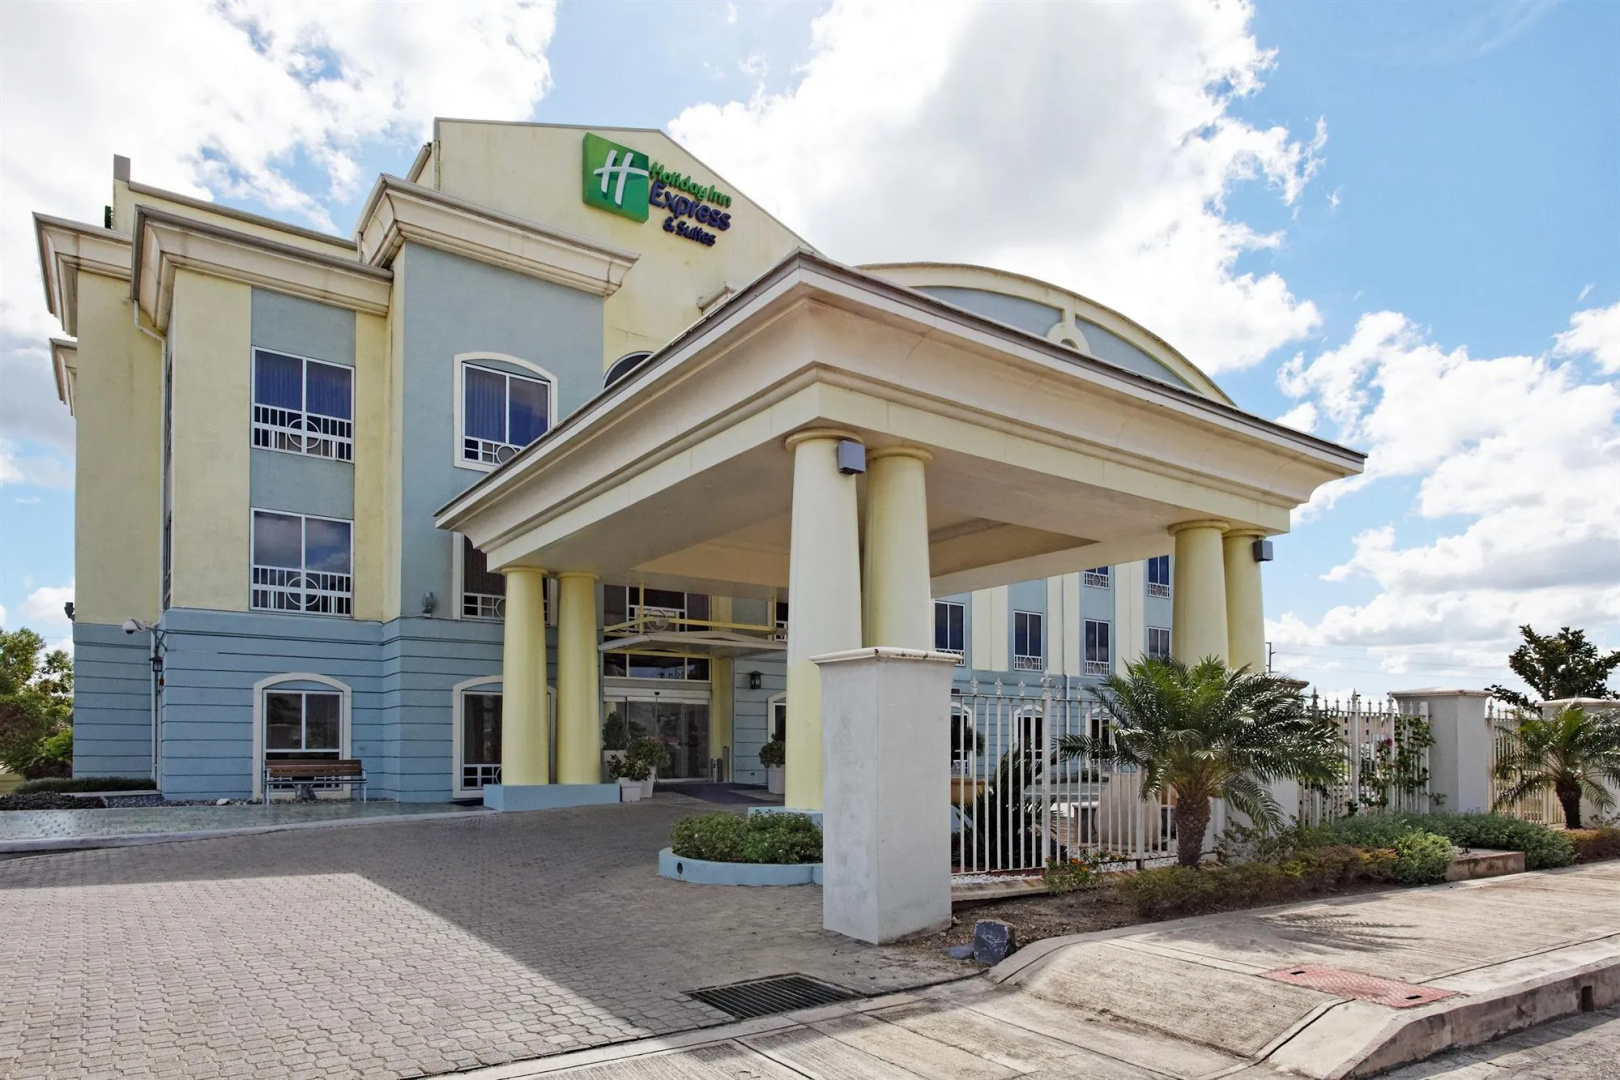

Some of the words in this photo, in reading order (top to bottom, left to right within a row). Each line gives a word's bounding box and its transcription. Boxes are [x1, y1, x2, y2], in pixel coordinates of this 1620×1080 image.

[649, 181, 732, 231] Express
[650, 162, 708, 200] Holiday
[708, 185, 732, 208] Inn
[663, 216, 675, 233] &
[676, 220, 716, 247] Suites
